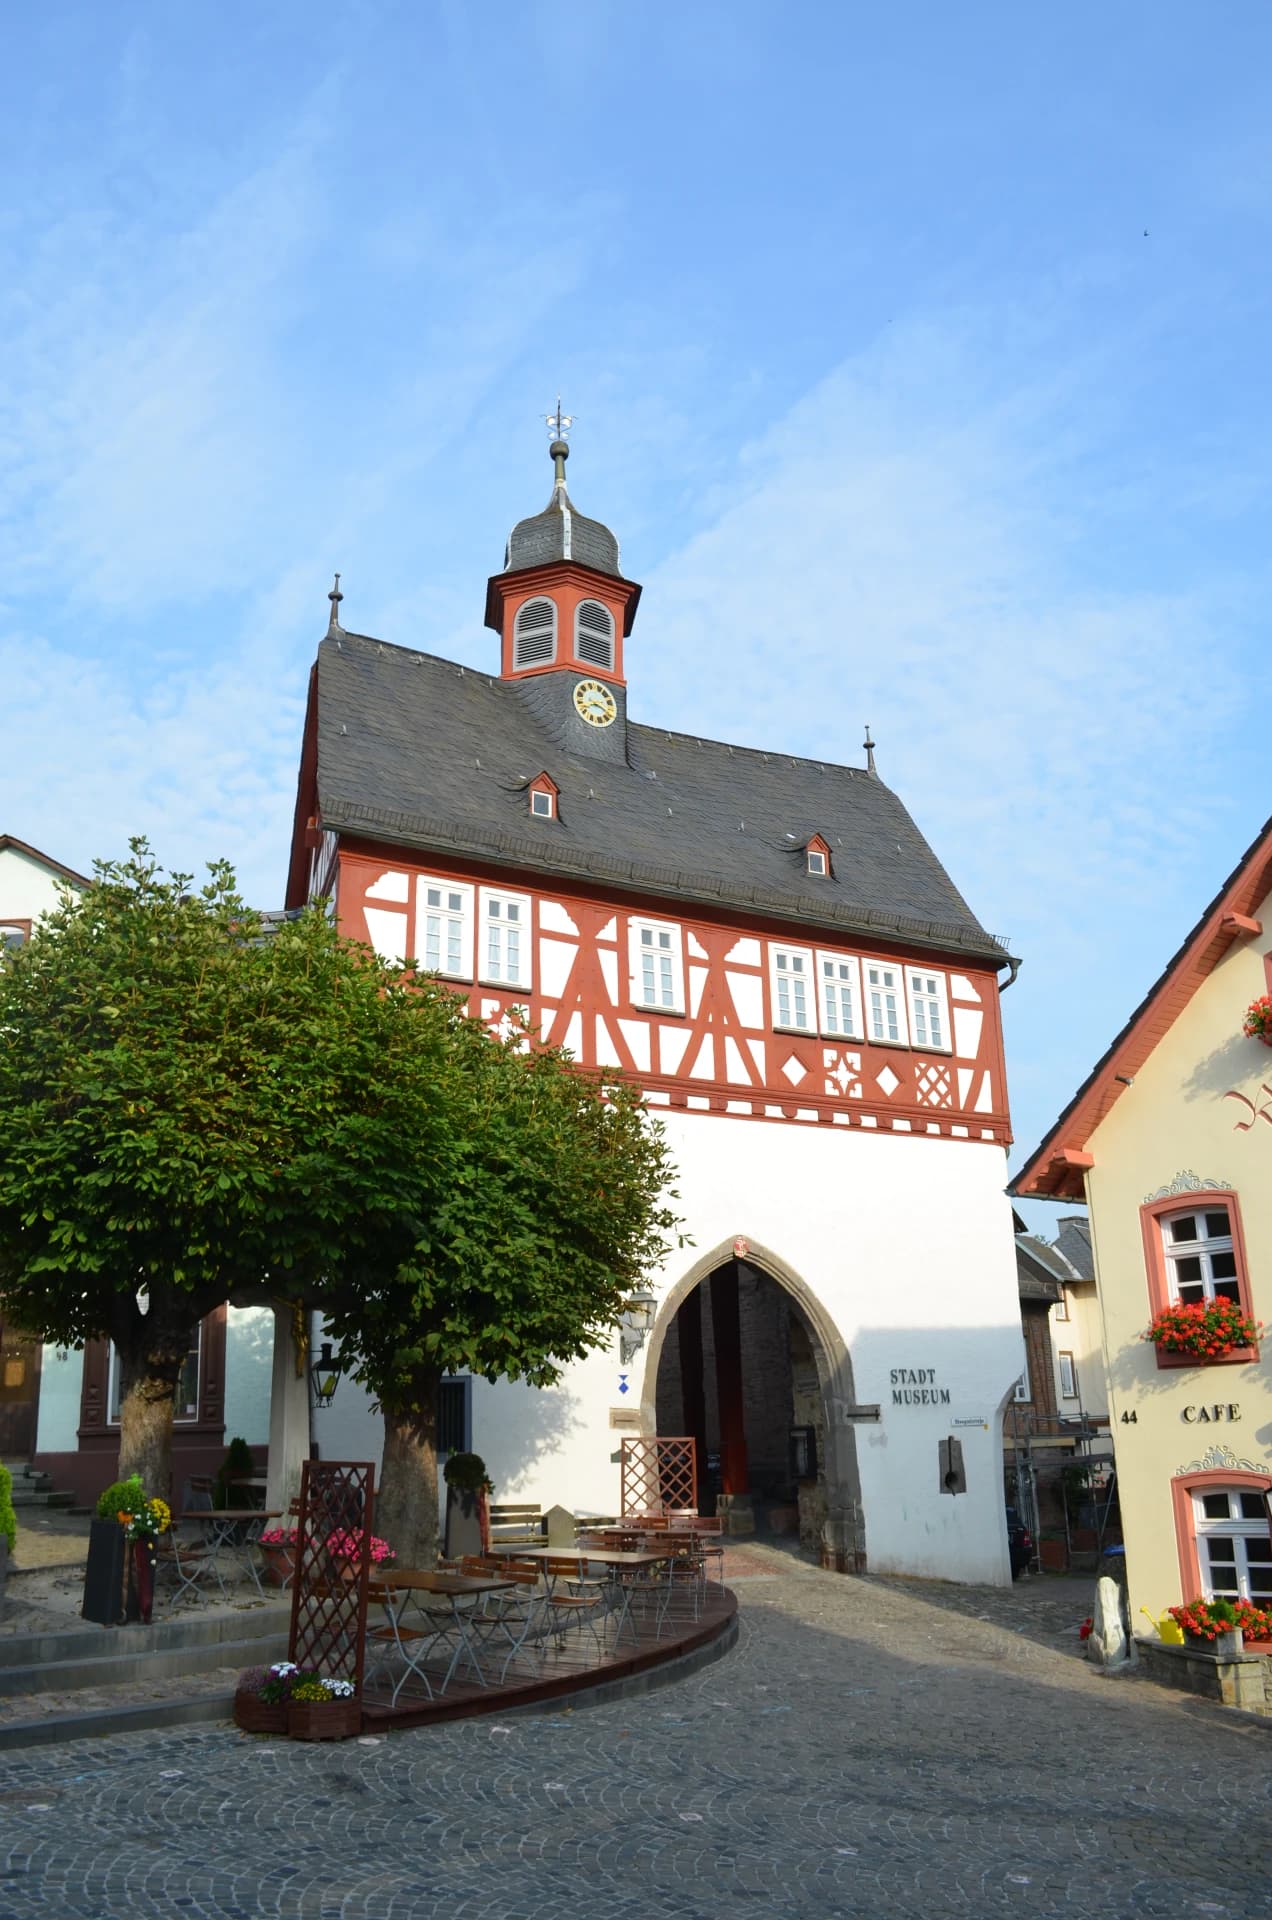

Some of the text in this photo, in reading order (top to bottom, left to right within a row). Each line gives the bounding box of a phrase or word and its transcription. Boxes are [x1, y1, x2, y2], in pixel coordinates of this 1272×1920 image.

[890, 1369, 936, 1384] STADT
[892, 1389, 951, 1405] MUSEUM
[1121, 1409, 1138, 1424] 44
[1182, 1403, 1242, 1424] CAFE
